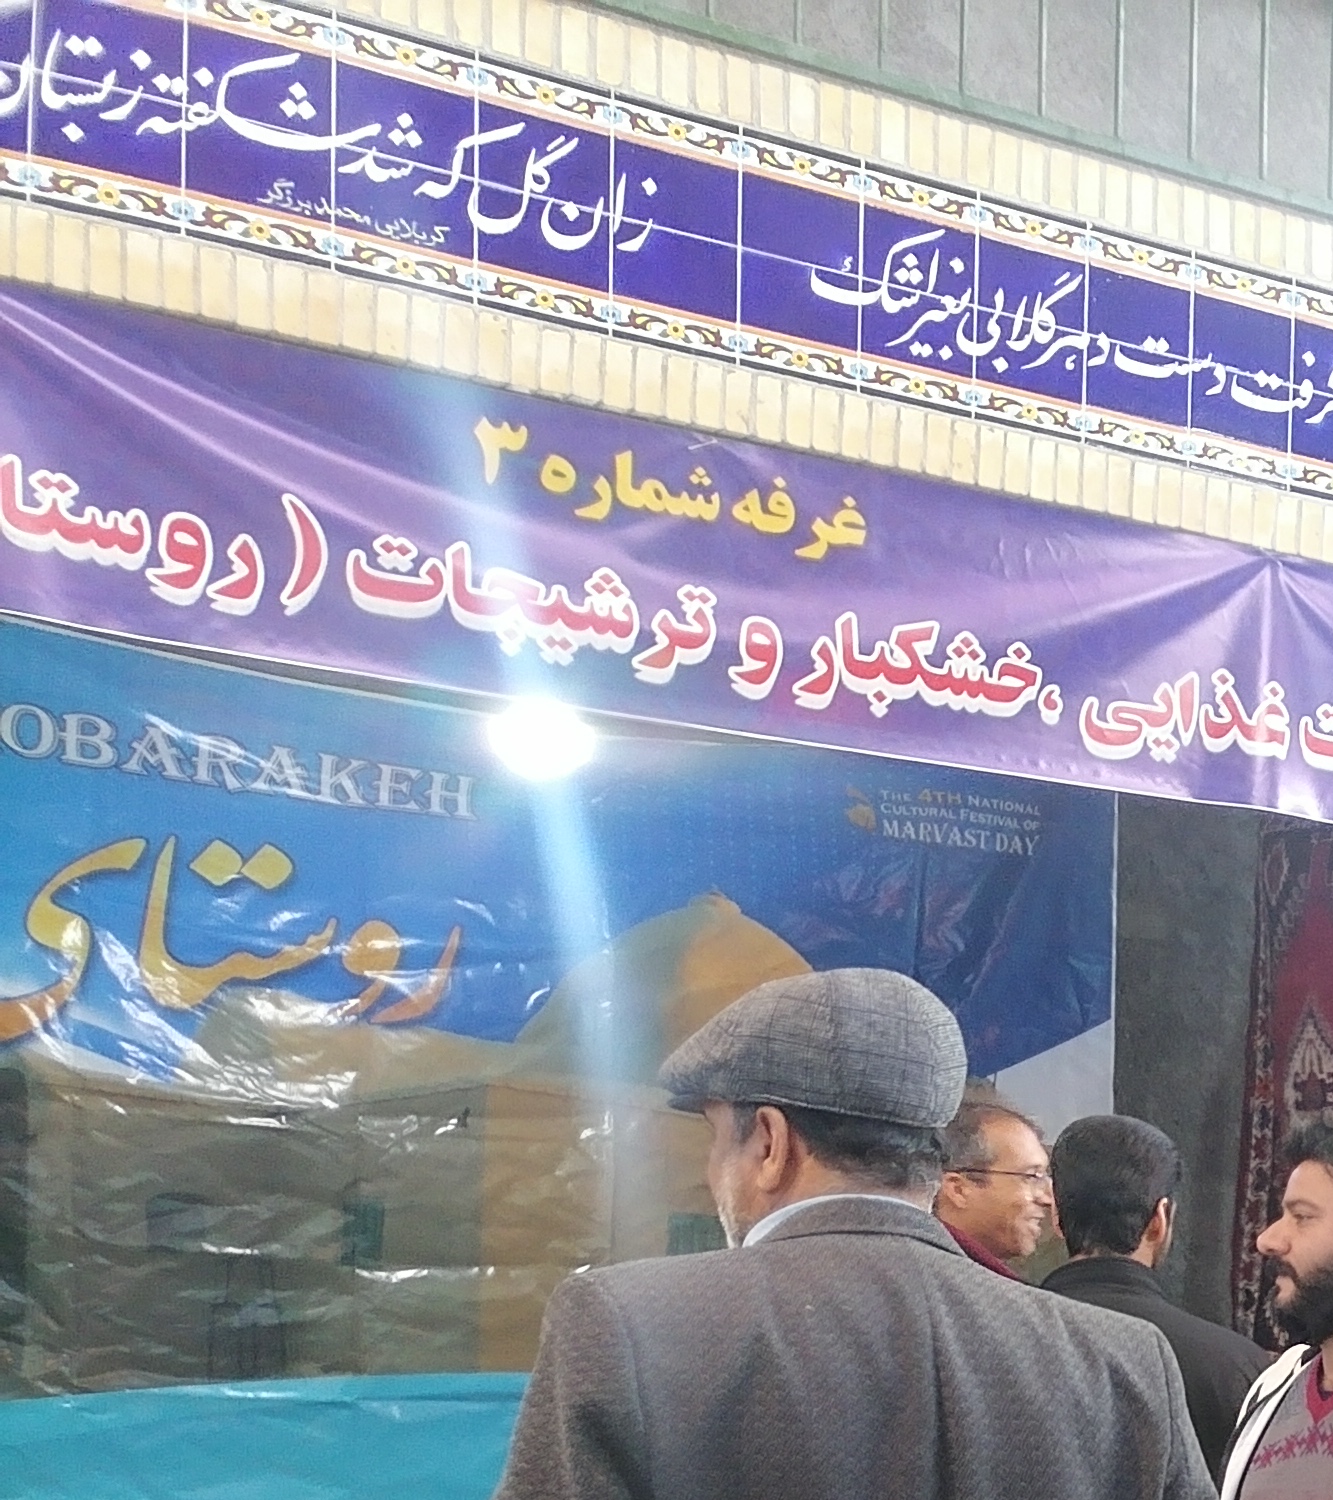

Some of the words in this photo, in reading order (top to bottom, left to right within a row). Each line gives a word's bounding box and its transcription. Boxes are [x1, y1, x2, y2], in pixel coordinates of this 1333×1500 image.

[338, 112, 423, 184] شد
[413, 121, 526, 199] که
[314, 196, 372, 226] محمد
[467, 134, 579, 236] گل
[474, 415, 529, 485] ۳
[540, 448, 721, 521] شماره
[733, 475, 868, 560] غرفه
[728, 615, 784, 700] و
[1079, 669, 1291, 764] غذایی
[880, 803, 956, 820] CULTURAL
[960, 808, 1020, 830] FESTIVAL
[883, 819, 990, 850] MARVAST
[996, 832, 1041, 856] DAY
[968, 795, 1041, 816] NATIONAL
[0, 835, 463, 1042] روستای
